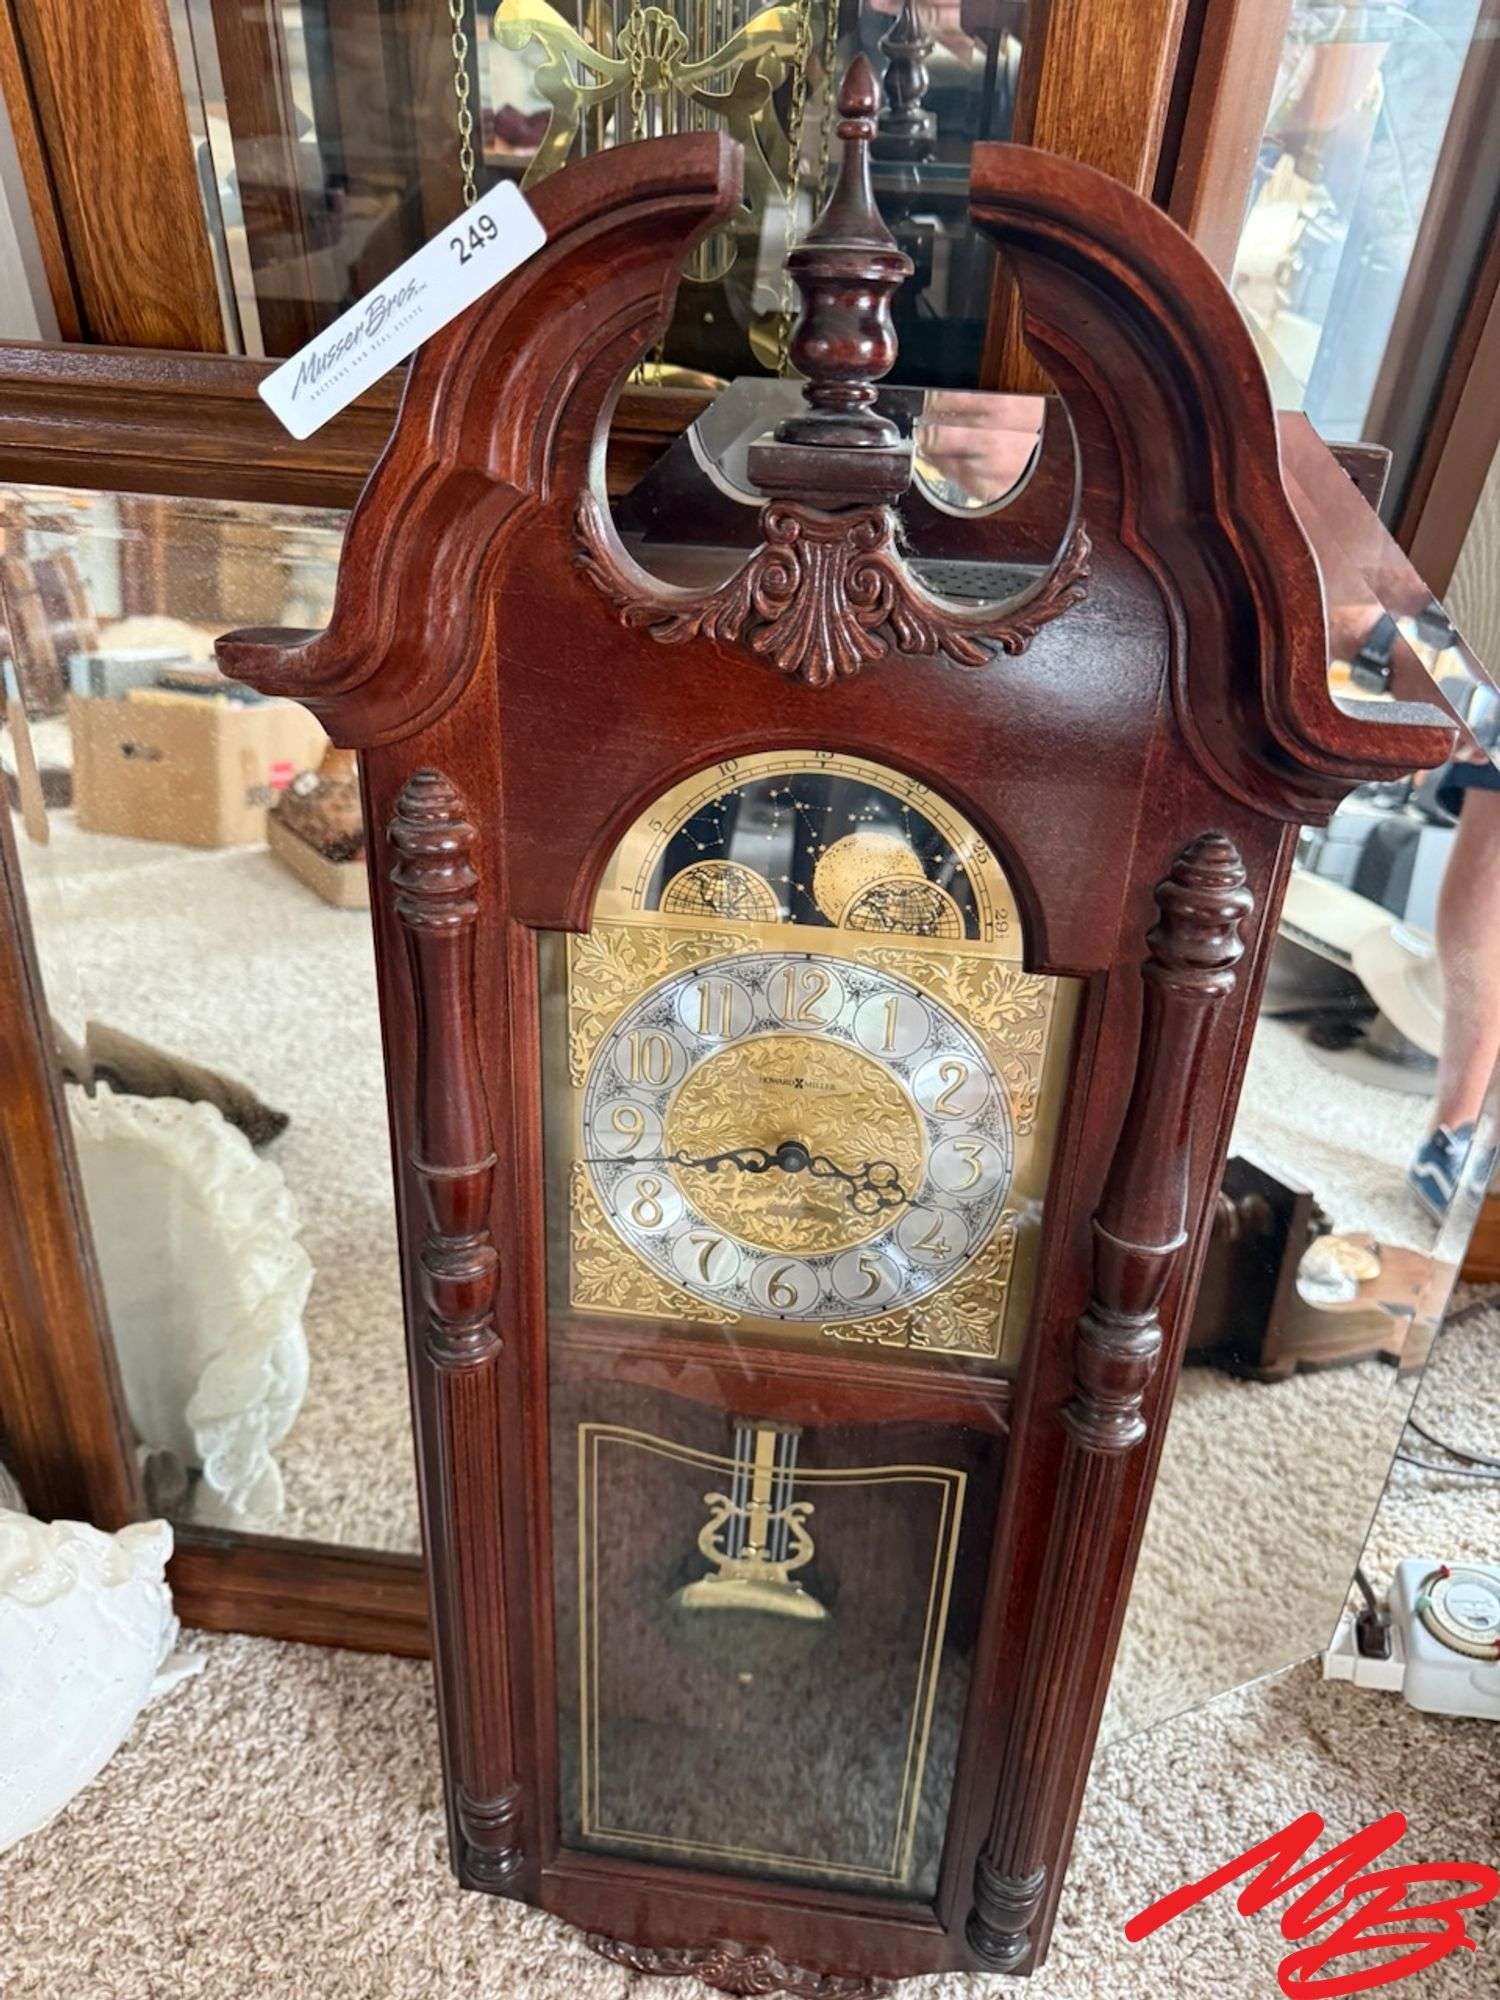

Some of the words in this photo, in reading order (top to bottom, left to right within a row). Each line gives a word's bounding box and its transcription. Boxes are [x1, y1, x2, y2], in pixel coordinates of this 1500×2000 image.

[450, 214, 499, 266] 249
[291, 322, 365, 401] Musser
[717, 759, 739, 777] 10
[648, 819, 662, 832] 5
[973, 838, 989, 864] 25
[696, 983, 732, 1038] 11
[782, 965, 831, 1029] 12
[882, 995, 898, 1053] 1
[627, 1030, 673, 1086] 10
[935, 1060, 967, 1117] 2
[611, 1105, 645, 1154] 9
[952, 1142, 984, 1192] 3
[632, 1179, 664, 1229] 8
[688, 1234, 722, 1283] 7
[911, 1212, 953, 1259] 4
[768, 1264, 798, 1309] 6
[856, 1252, 885, 1300] 5
